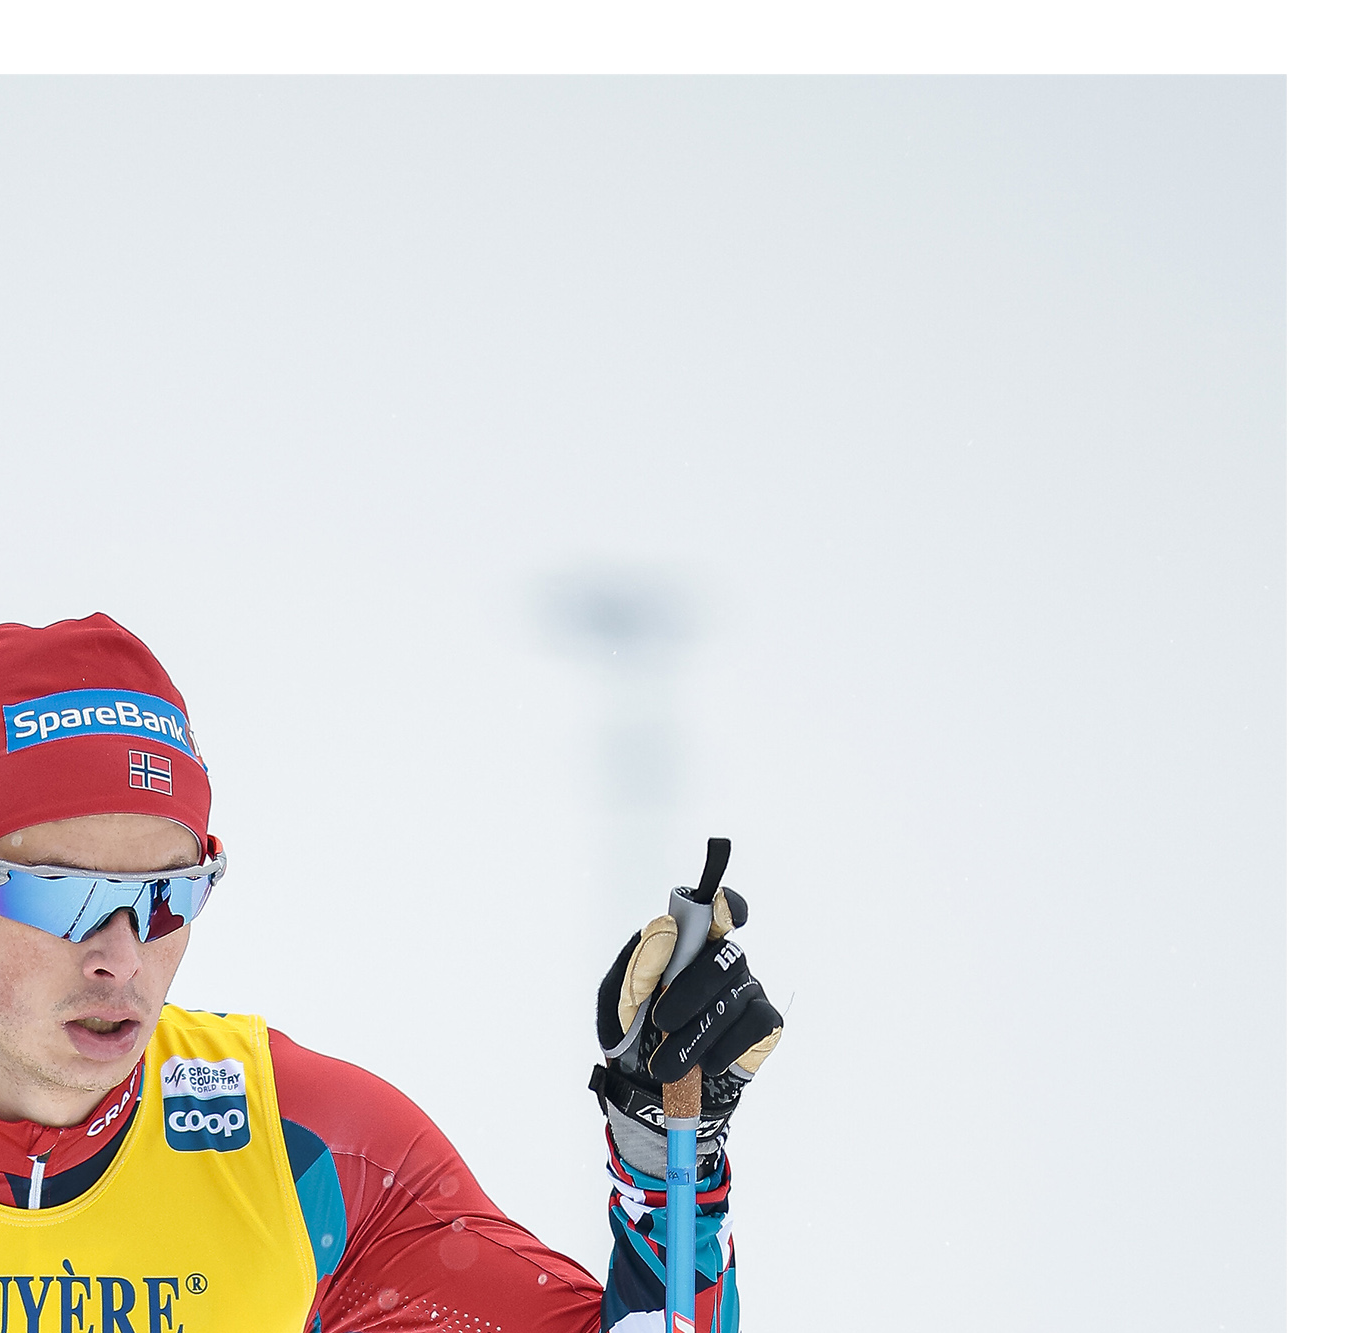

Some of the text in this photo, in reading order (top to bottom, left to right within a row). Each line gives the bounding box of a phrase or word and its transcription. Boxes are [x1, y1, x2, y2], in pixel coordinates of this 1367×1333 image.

[14, 701, 187, 746] SpareBank
[188, 1066, 227, 1077] CROSS
[189, 1073, 241, 1086] COUNTRY
[191, 1083, 239, 1093] WORLD CUP
[168, 1109, 245, 1138] coop
